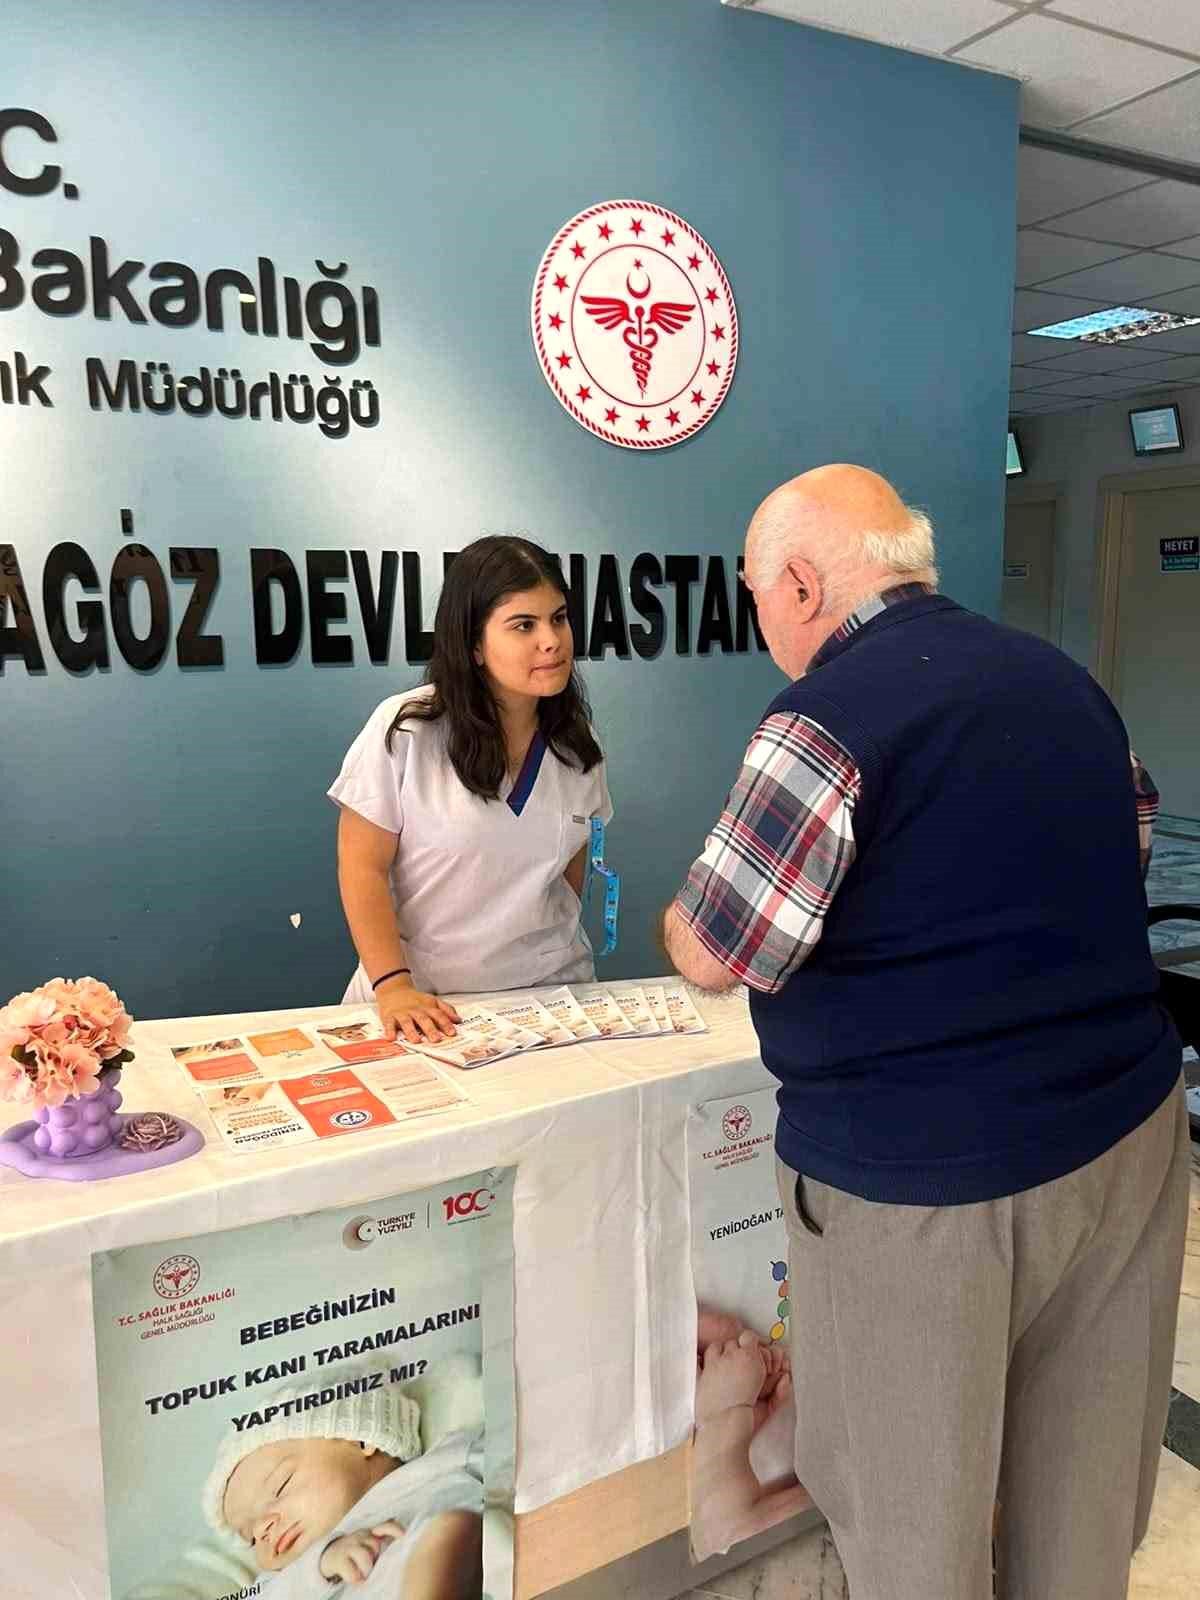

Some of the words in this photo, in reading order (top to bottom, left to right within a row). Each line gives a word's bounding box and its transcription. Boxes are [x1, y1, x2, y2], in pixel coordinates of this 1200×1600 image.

[86, 357, 380, 438] Müdürlüğü
[250, 547, 463, 668] DEVL
[709, 1211, 773, 1241] YENİDOĞAN
[138, 1304, 177, 1321] SAĞLIK
[179, 1288, 235, 1310] BAKANLIĞI
[240, 1287, 396, 1345] BEBEĞİNİZİN
[145, 1374, 238, 1416] TOPUK
[244, 1356, 306, 1388] KANI
[313, 1303, 480, 1365] TARAMALARINI
[231, 1373, 383, 1433] YAPTIRDINIZ
[389, 1359, 429, 1385] MI?
